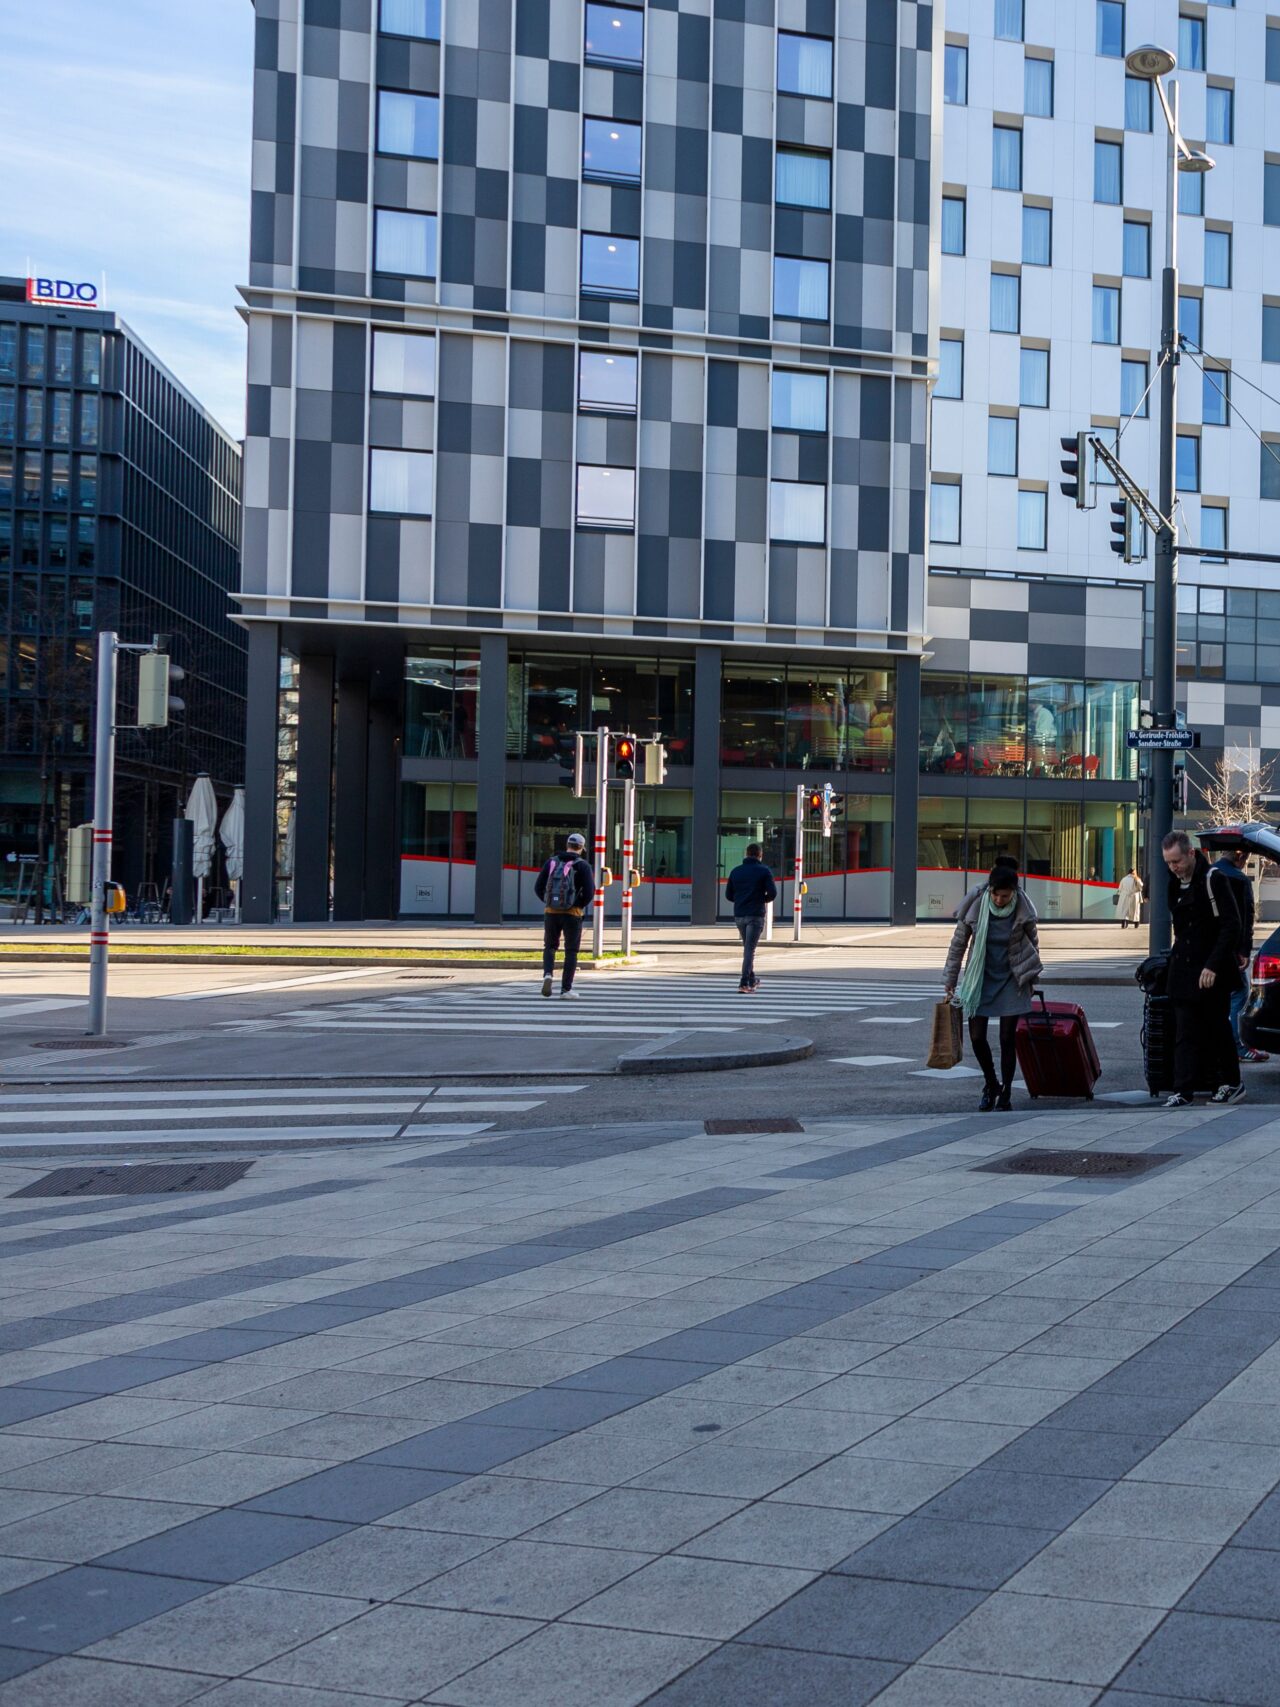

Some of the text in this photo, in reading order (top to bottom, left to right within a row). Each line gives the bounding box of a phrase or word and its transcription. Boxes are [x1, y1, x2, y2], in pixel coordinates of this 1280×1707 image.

[36, 278, 98, 302] BDO
[1138, 731, 1192, 739] Gertrude-Fröhlich-
[1137, 739, 1182, 747] Sandner-Straße
